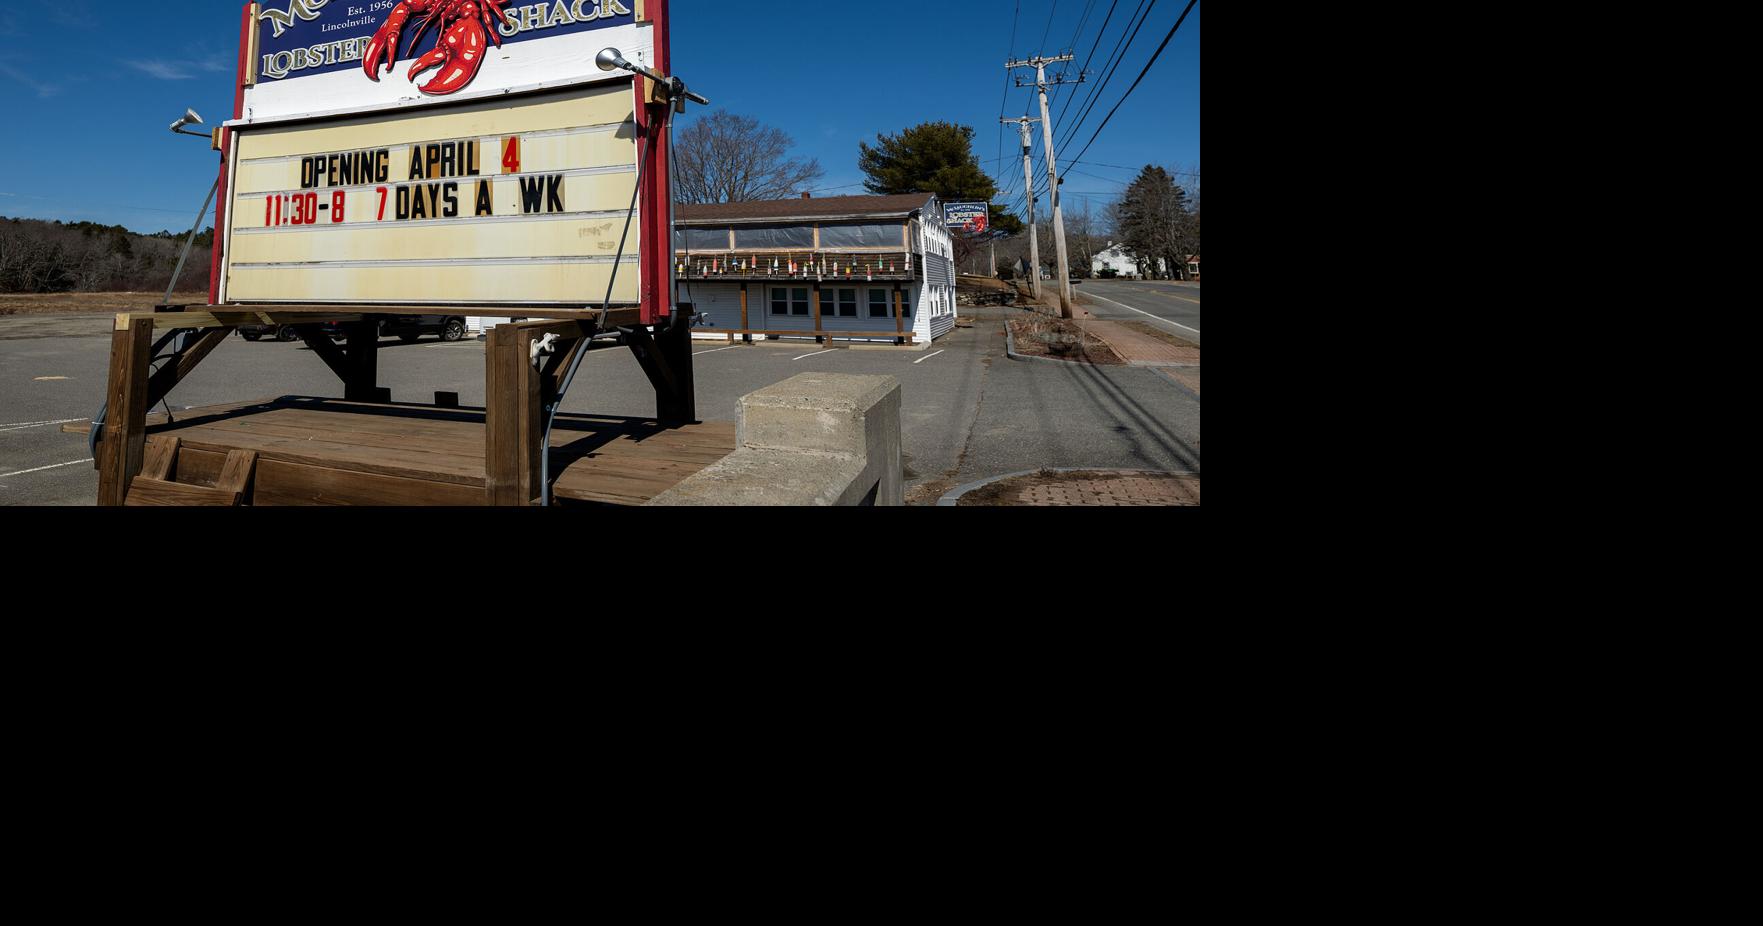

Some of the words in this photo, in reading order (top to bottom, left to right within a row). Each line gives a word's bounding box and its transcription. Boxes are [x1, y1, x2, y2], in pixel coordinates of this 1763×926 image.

[321, 16, 376, 32] Lincolnville
[347, 5, 366, 16] Est.
[369, 0, 393, 12] 1956
[498, 0, 630, 36] SHACK
[301, 148, 389, 188] OPENING
[409, 141, 480, 180] APRIL
[502, 136, 520, 173] 4
[376, 186, 388, 221] 7
[396, 181, 458, 220] DAYS
[475, 179, 493, 215] A
[519, 174, 564, 213] WK
